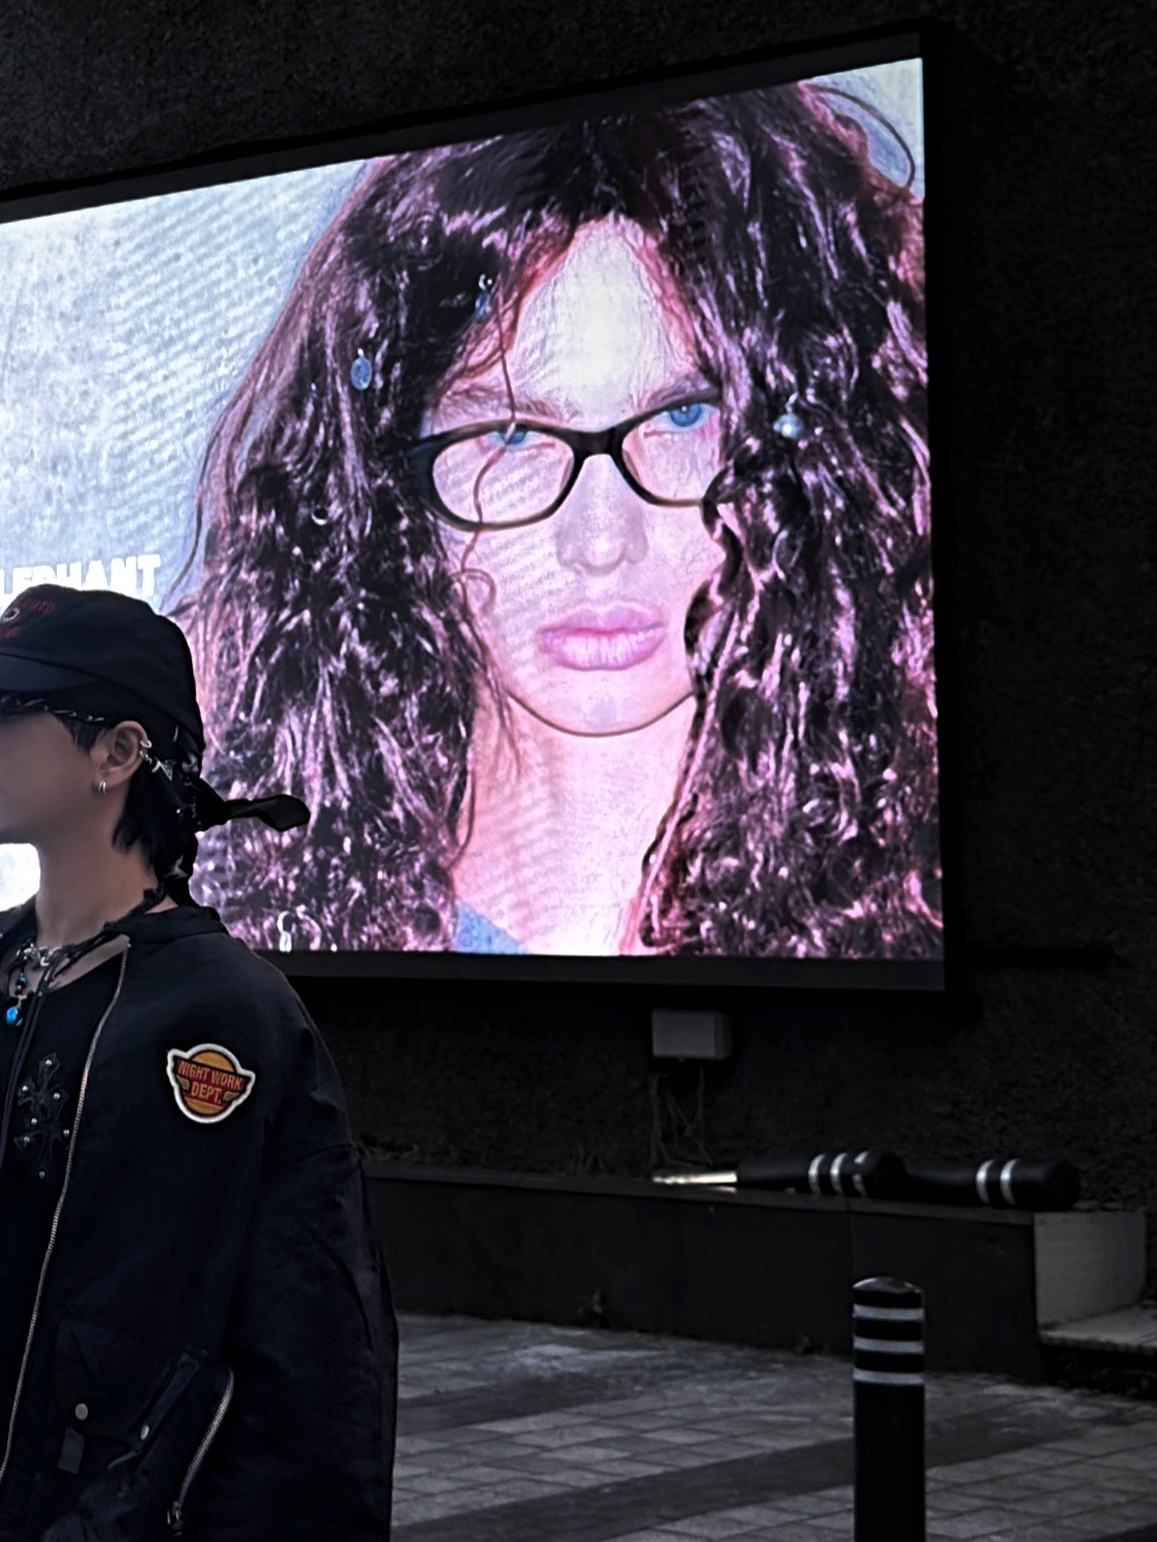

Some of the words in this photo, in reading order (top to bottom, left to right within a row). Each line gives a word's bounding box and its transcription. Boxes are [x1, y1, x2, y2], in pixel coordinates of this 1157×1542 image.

[177, 1060, 211, 1082] NIGHT
[211, 1069, 243, 1091] WORK
[190, 1081, 223, 1104] DEPT.
